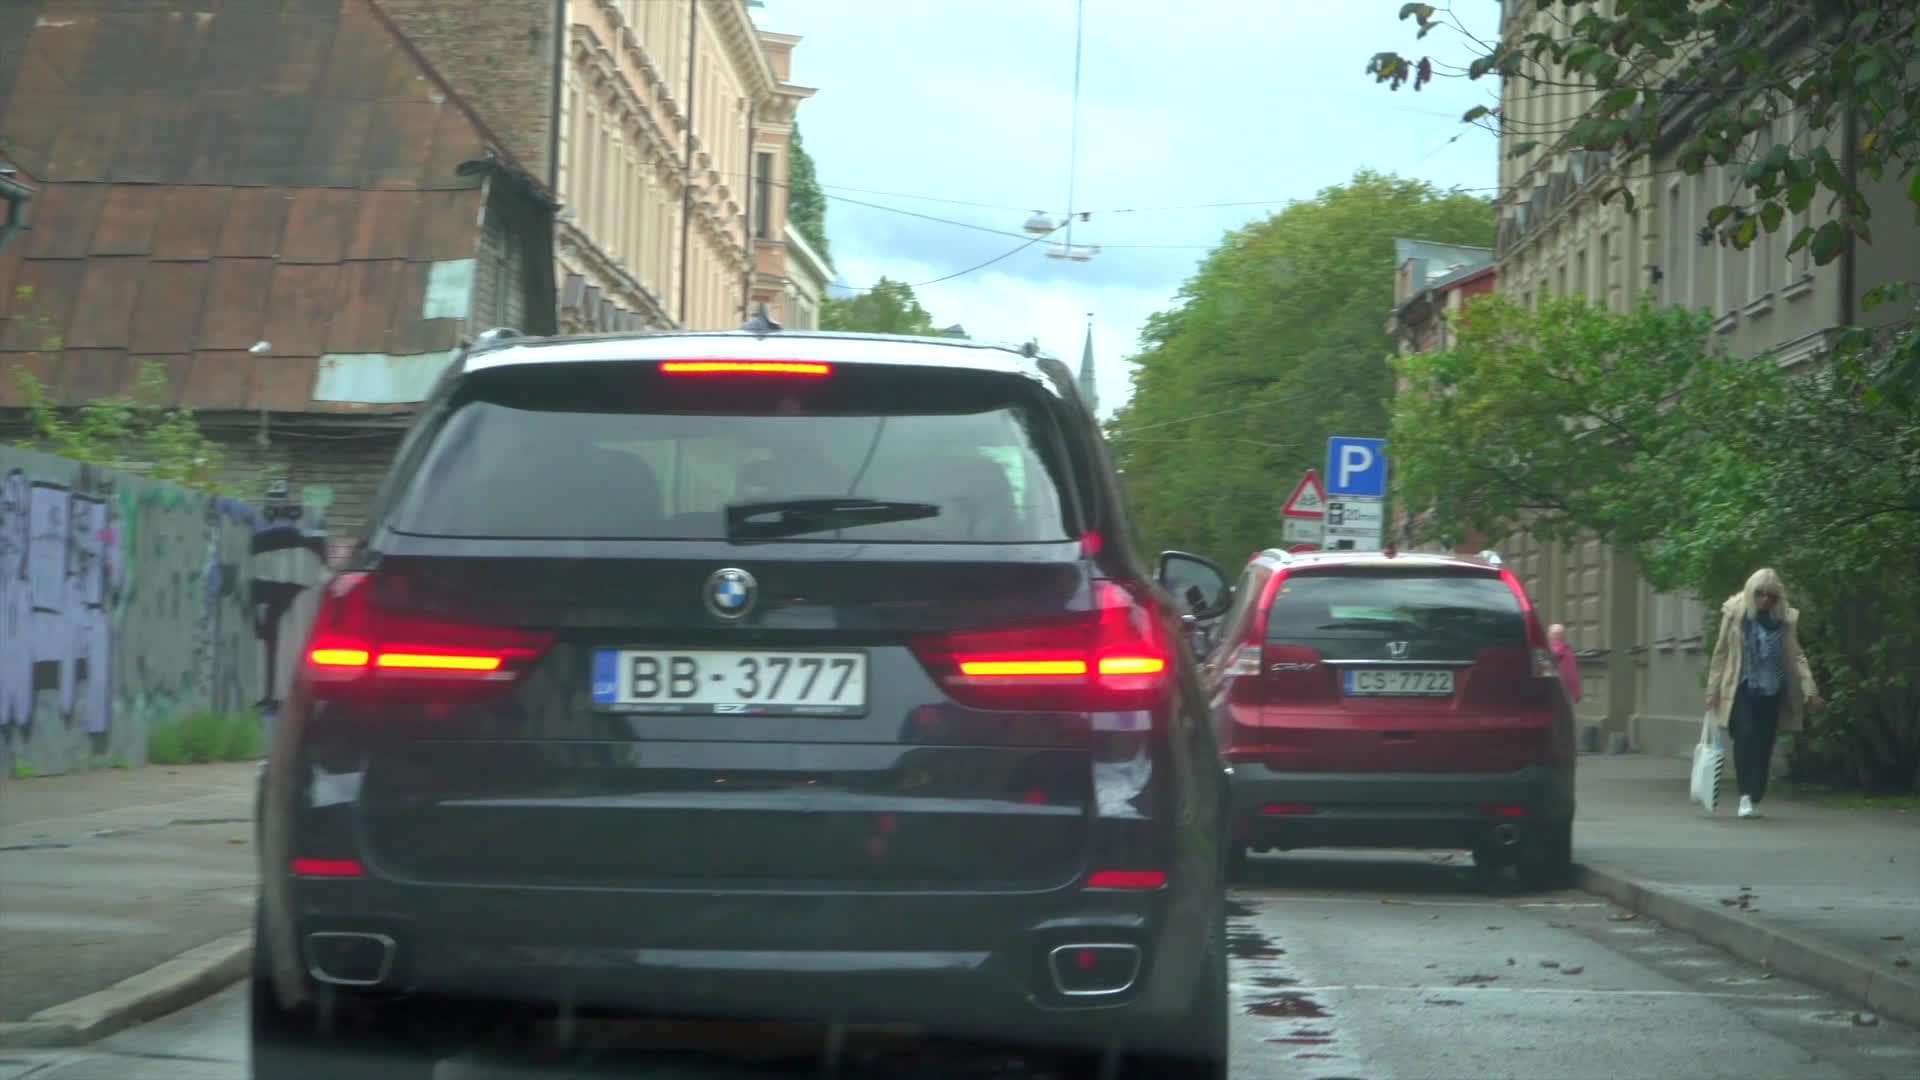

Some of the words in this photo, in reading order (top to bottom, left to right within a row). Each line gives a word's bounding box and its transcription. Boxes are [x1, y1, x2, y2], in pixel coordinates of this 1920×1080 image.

[1339, 445, 1373, 488] P
[631, 656, 857, 701] BB-3777
[1358, 671, 1449, 691] CS-7722
